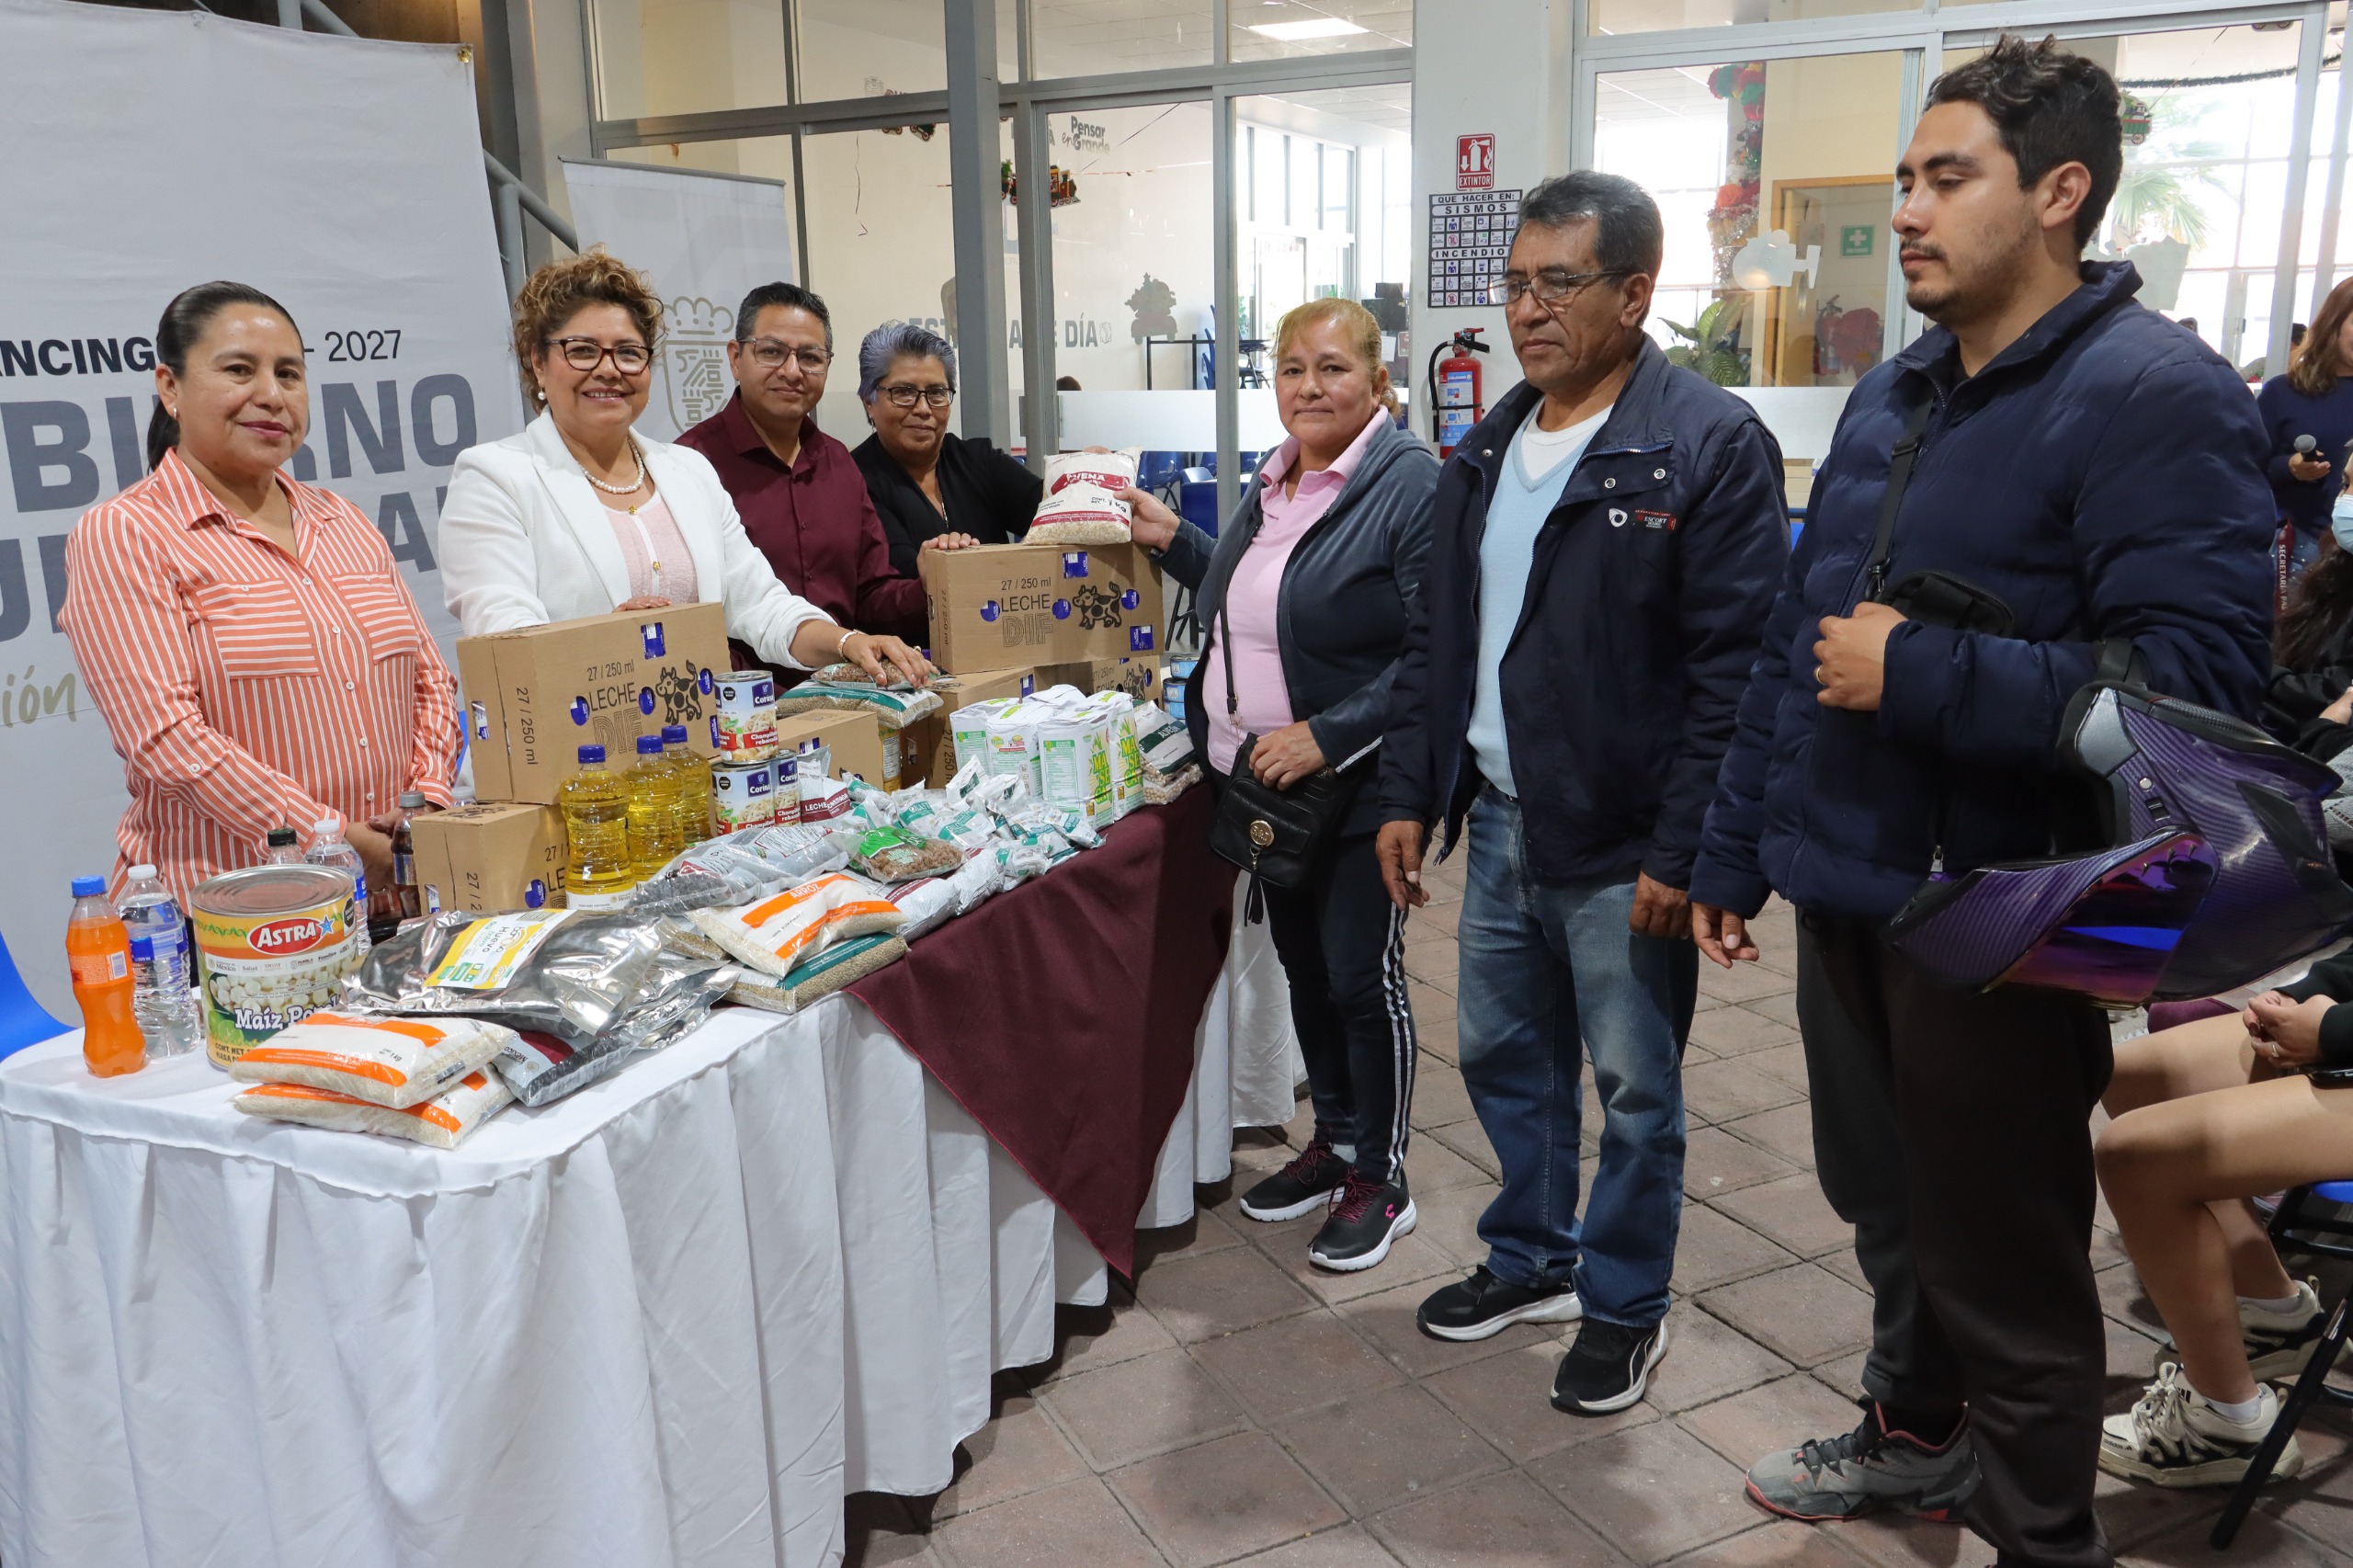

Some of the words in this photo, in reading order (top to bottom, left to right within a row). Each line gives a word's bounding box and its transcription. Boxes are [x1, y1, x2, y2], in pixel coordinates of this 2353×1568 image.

[1071, 116, 1106, 139] Pensar
[1459, 176, 1491, 187] EXTINTOR
[1438, 195, 1458, 203] QUE
[1462, 193, 1494, 202] HACER
[1499, 193, 1515, 201] EN:
[1445, 203, 1507, 215] SISMOS
[1436, 248, 1505, 258] INCENDIO
[1065, 312, 1098, 348] DÍA
[0, 336, 157, 378] NCING
[324, 330, 402, 363] 2027
[1644, 516, 1667, 524] ESCORT
[2279, 544, 2288, 595] SECRETARIA
[1001, 581, 1012, 591] 27
[1021, 578, 1038, 589] 250
[1040, 577, 1051, 587] ml
[1001, 594, 1051, 613] LECHE
[1003, 613, 1053, 648] DIF
[587, 667, 598, 682] 27
[606, 663, 622, 678] 250
[624, 658, 635, 674] ml
[1094, 680, 1115, 693] ECHE
[2, 664, 77, 731] ión
[516, 687, 530, 705] 27
[588, 683, 637, 712] LECHE
[520, 718, 536, 744] 250
[943, 729, 952, 742] 27
[1121, 736, 1137, 756] MA
[525, 748, 539, 765] ml
[944, 752, 955, 771] 250
[1093, 751, 1108, 772] MA
[1129, 753, 1141, 769] SE
[946, 774, 953, 783] m
[1098, 768, 1111, 786] SE
[804, 801, 828, 812] LECHE
[545, 846, 557, 862] 27
[466, 872, 480, 890] 27
[790, 883, 823, 900] ARROZ
[482, 926, 510, 953] Huevo
[234, 1006, 284, 1030] Maíz
[216, 1052, 232, 1062] MASA
[2103, 1438, 2124, 1450] adidas
